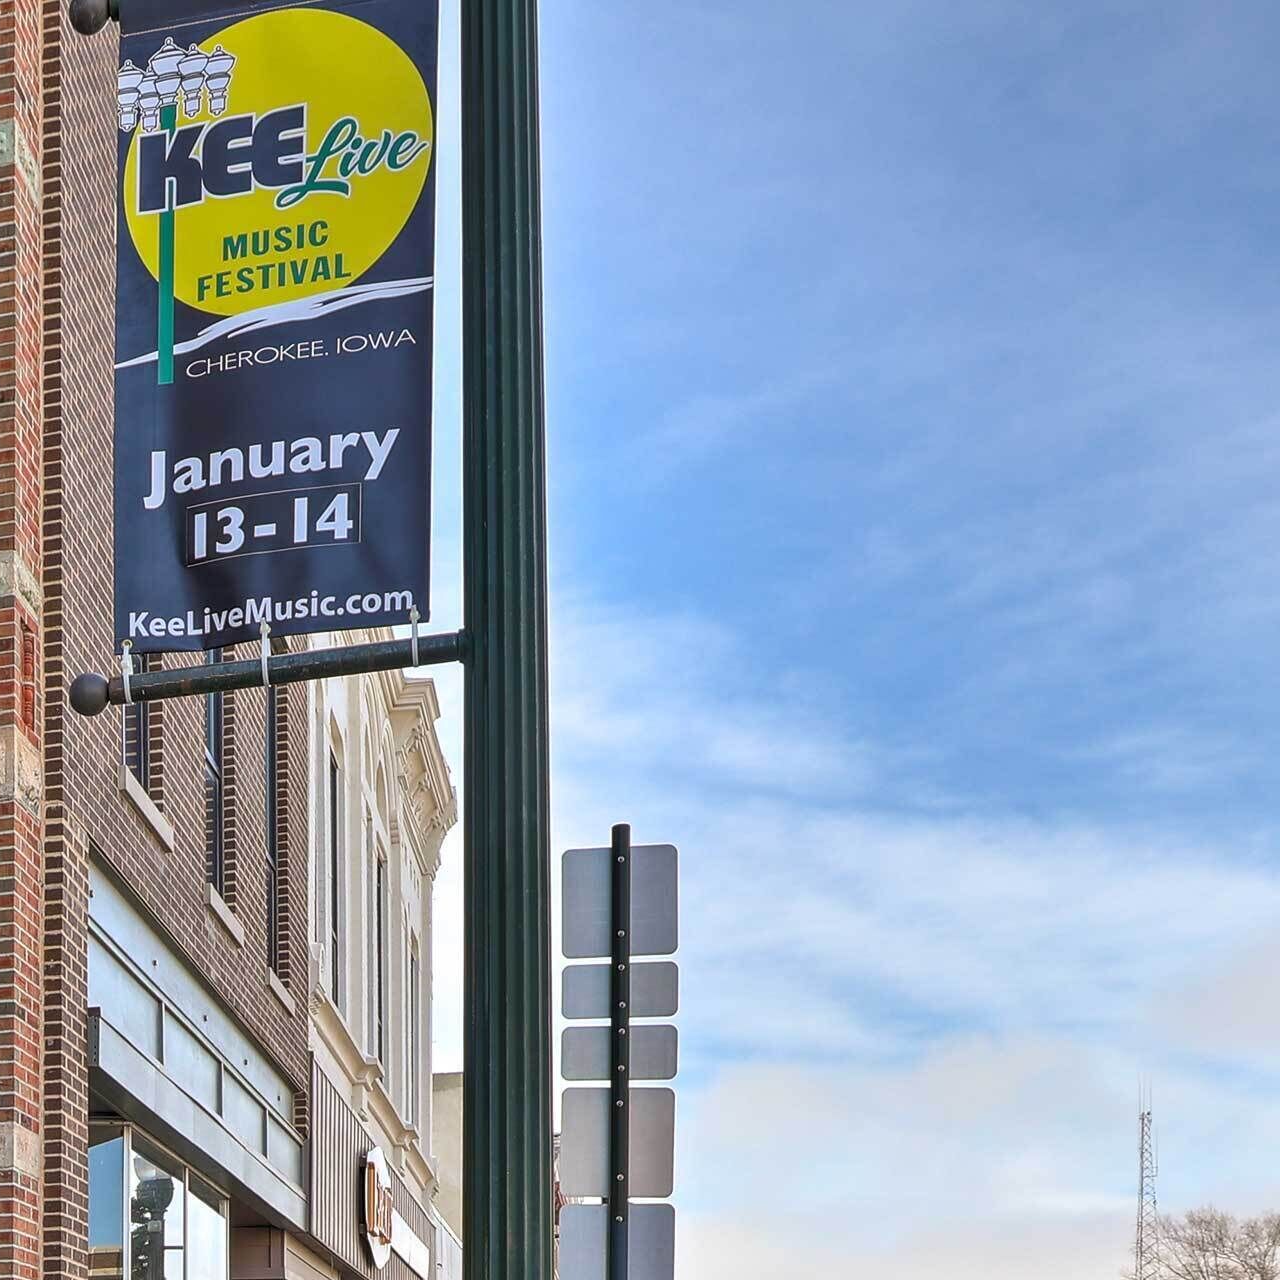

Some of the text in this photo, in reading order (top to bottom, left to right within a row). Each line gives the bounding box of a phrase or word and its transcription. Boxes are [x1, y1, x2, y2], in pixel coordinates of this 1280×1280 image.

[135, 103, 430, 216] KEE Live
[221, 218, 329, 262] MUSIC
[197, 250, 352, 302] FESTIVAL
[336, 329, 416, 355] IOWA
[143, 428, 401, 510] January
[127, 586, 415, 640] KeeLiveMusic.com
